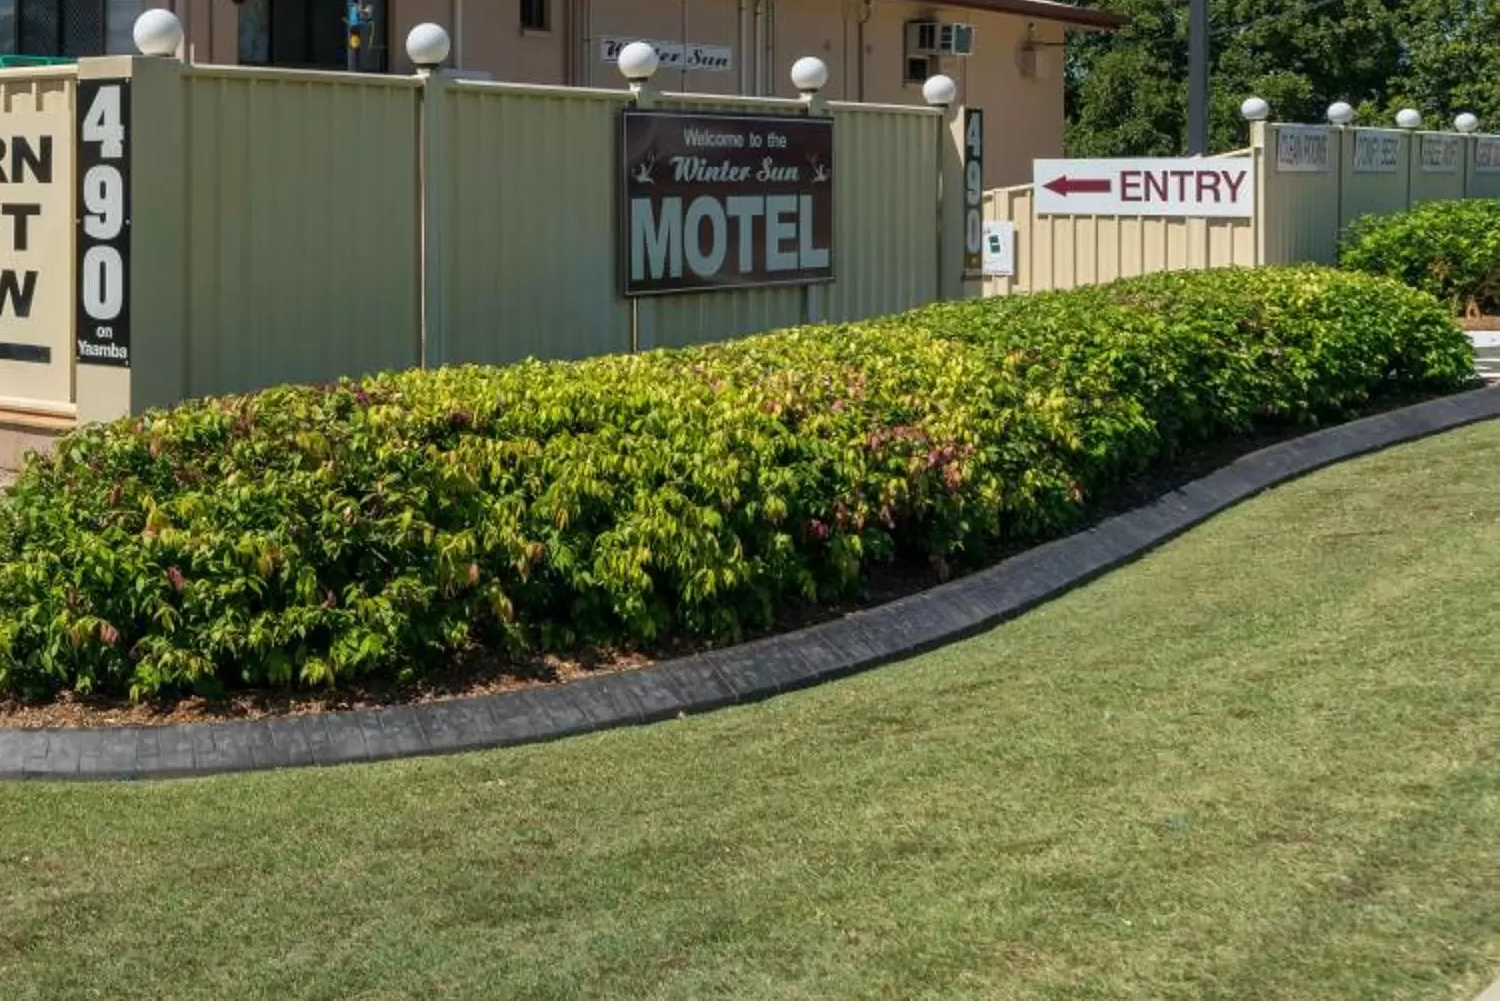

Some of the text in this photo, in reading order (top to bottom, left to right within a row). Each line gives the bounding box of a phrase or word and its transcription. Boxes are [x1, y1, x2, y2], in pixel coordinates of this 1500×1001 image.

[687, 48, 728, 67] Sun
[683, 127, 787, 148] Welcome to the
[671, 155, 799, 183] Winter Sun
[1119, 170, 1248, 203] ENTRY
[82, 85, 125, 320] 490
[631, 194, 829, 280] MOTEL
[95, 326, 113, 339] on
[77, 339, 128, 359] Yaamba
